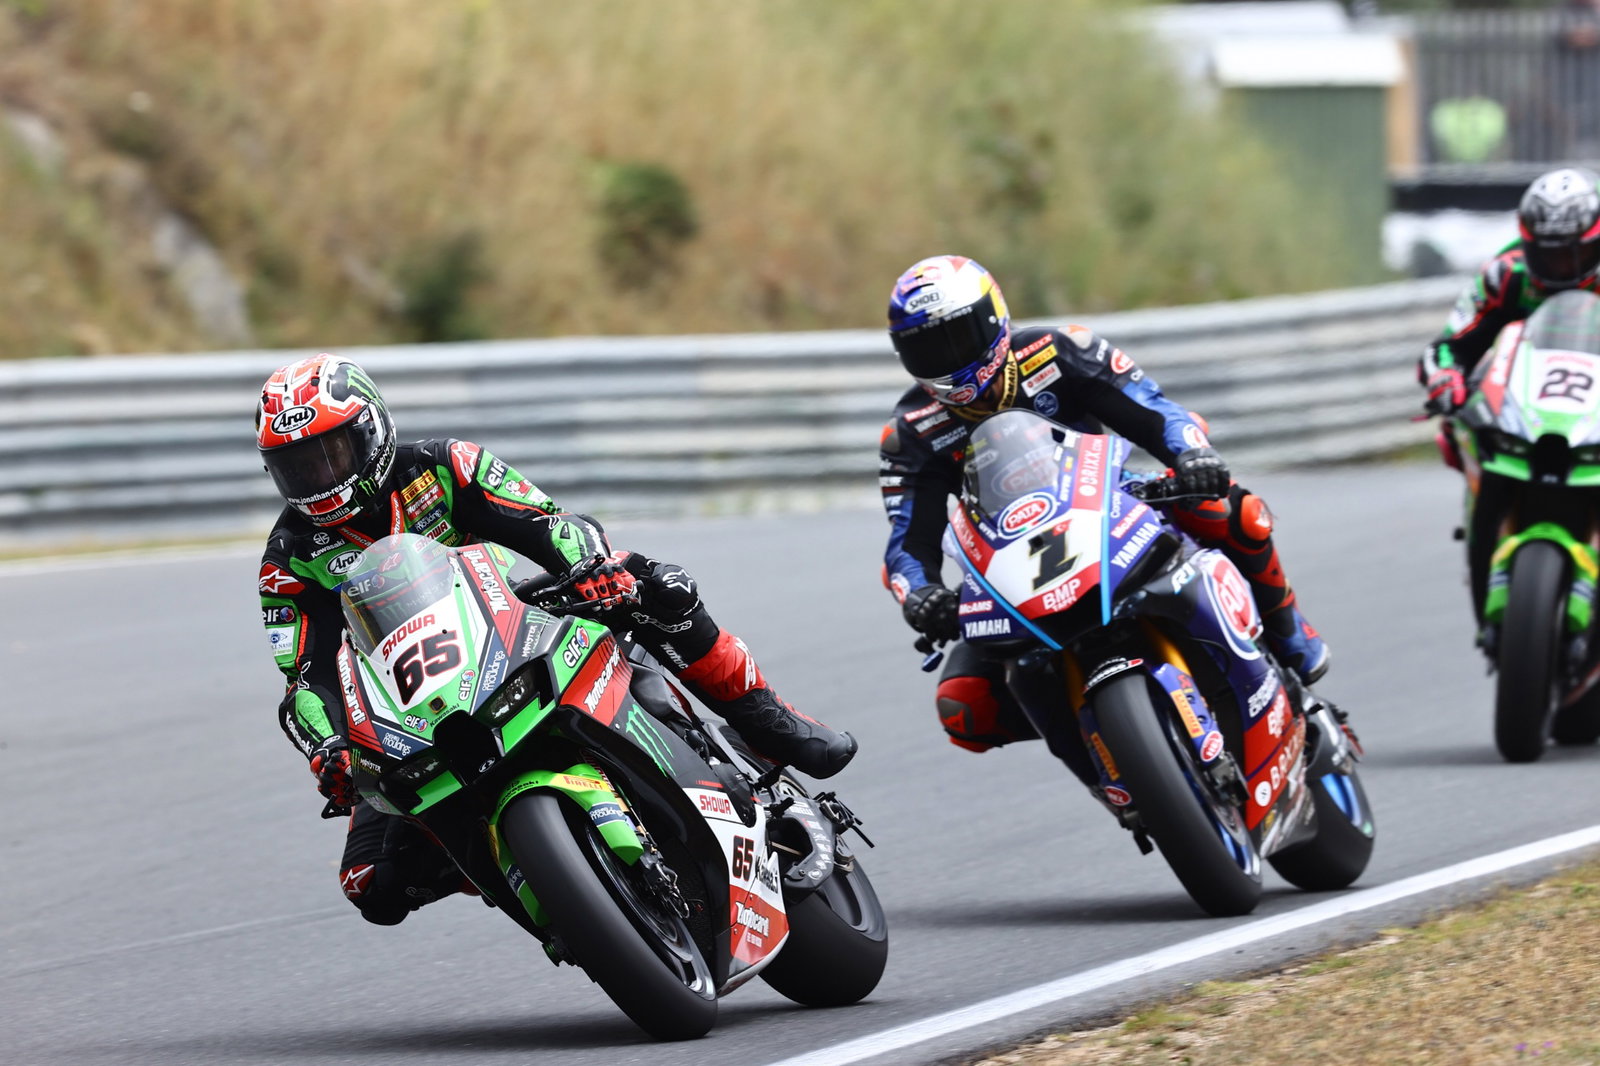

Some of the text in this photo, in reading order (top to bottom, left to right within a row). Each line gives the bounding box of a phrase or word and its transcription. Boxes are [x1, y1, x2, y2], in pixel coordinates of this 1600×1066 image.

[909, 291, 940, 310] SHOEI
[1537, 368, 1594, 404] 22
[276, 407, 310, 429] Arai
[487, 459, 505, 488] elf
[312, 506, 350, 524] Medallia
[1008, 502, 1042, 526] PATA
[1111, 504, 1148, 539] McAMS
[310, 539, 346, 559] Kawasaki
[1027, 520, 1081, 593] 1
[1111, 522, 1161, 569] YAMAHA
[330, 551, 360, 574] Arai
[347, 580, 373, 598] elf
[462, 549, 511, 616] Motocard
[959, 600, 993, 614] McAMS
[1042, 579, 1081, 611] BMP
[382, 614, 436, 662] SHOWA
[965, 618, 1011, 638] YAMAHA
[563, 641, 581, 669] elf
[393, 630, 461, 706] 65
[584, 644, 621, 715] Motocard
[459, 678, 472, 701] elf
[404, 714, 421, 729] elf
[429, 703, 460, 728] Kawasaki
[563, 775, 603, 791] PIRELLI
[700, 794, 732, 816] SHOWA
[732, 834, 755, 882] 65
